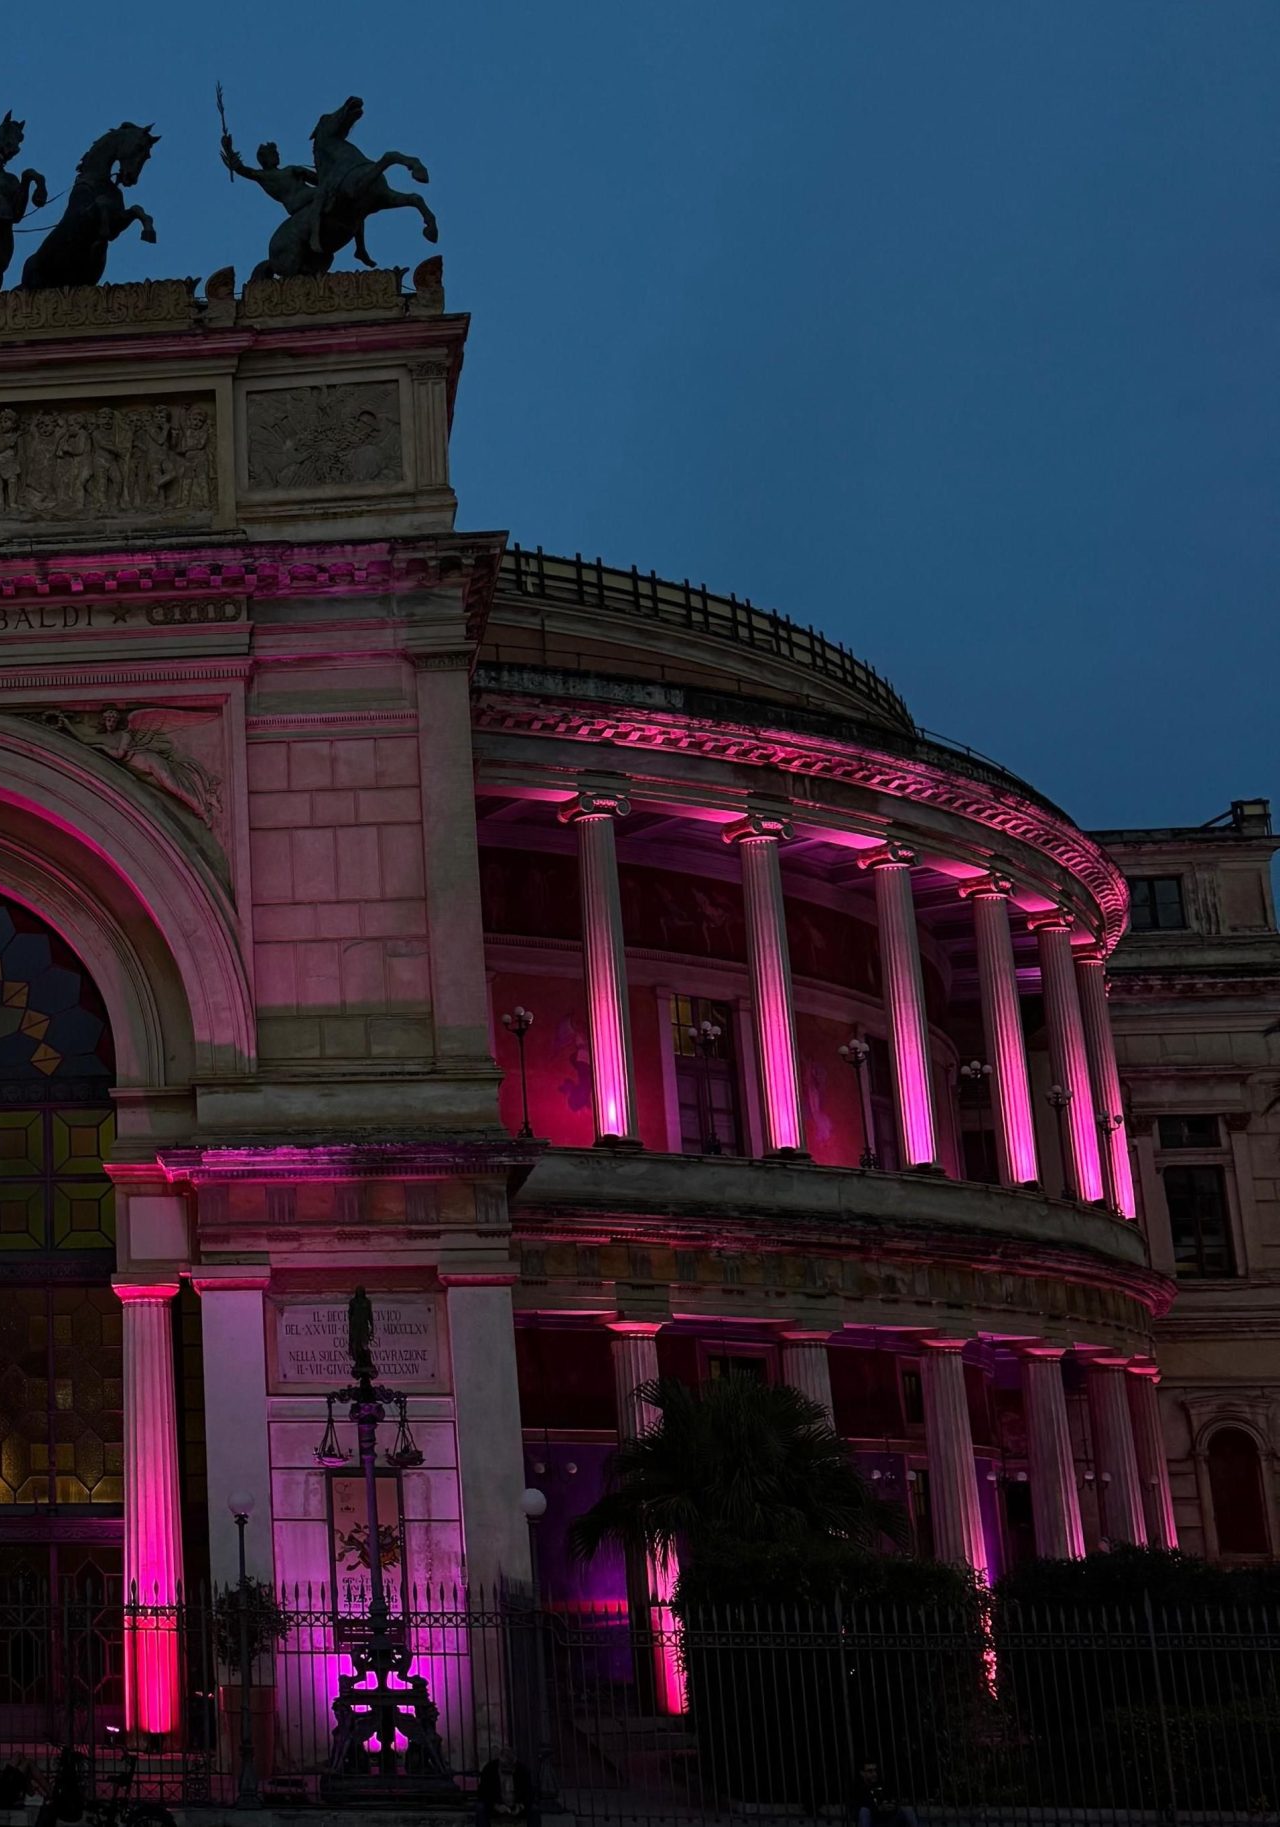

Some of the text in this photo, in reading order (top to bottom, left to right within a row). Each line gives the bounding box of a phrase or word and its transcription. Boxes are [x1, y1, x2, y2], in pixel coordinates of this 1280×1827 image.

[312, 1311, 322, 1322] IL
[285, 1324, 300, 1335] DEL
[305, 1323, 337, 1335] XXVIII
[289, 1350, 317, 1361] NELLA
[319, 1350, 354, 1361] SOLENN
[296, 1364, 305, 1375] IL
[309, 1364, 322, 1375] VII
